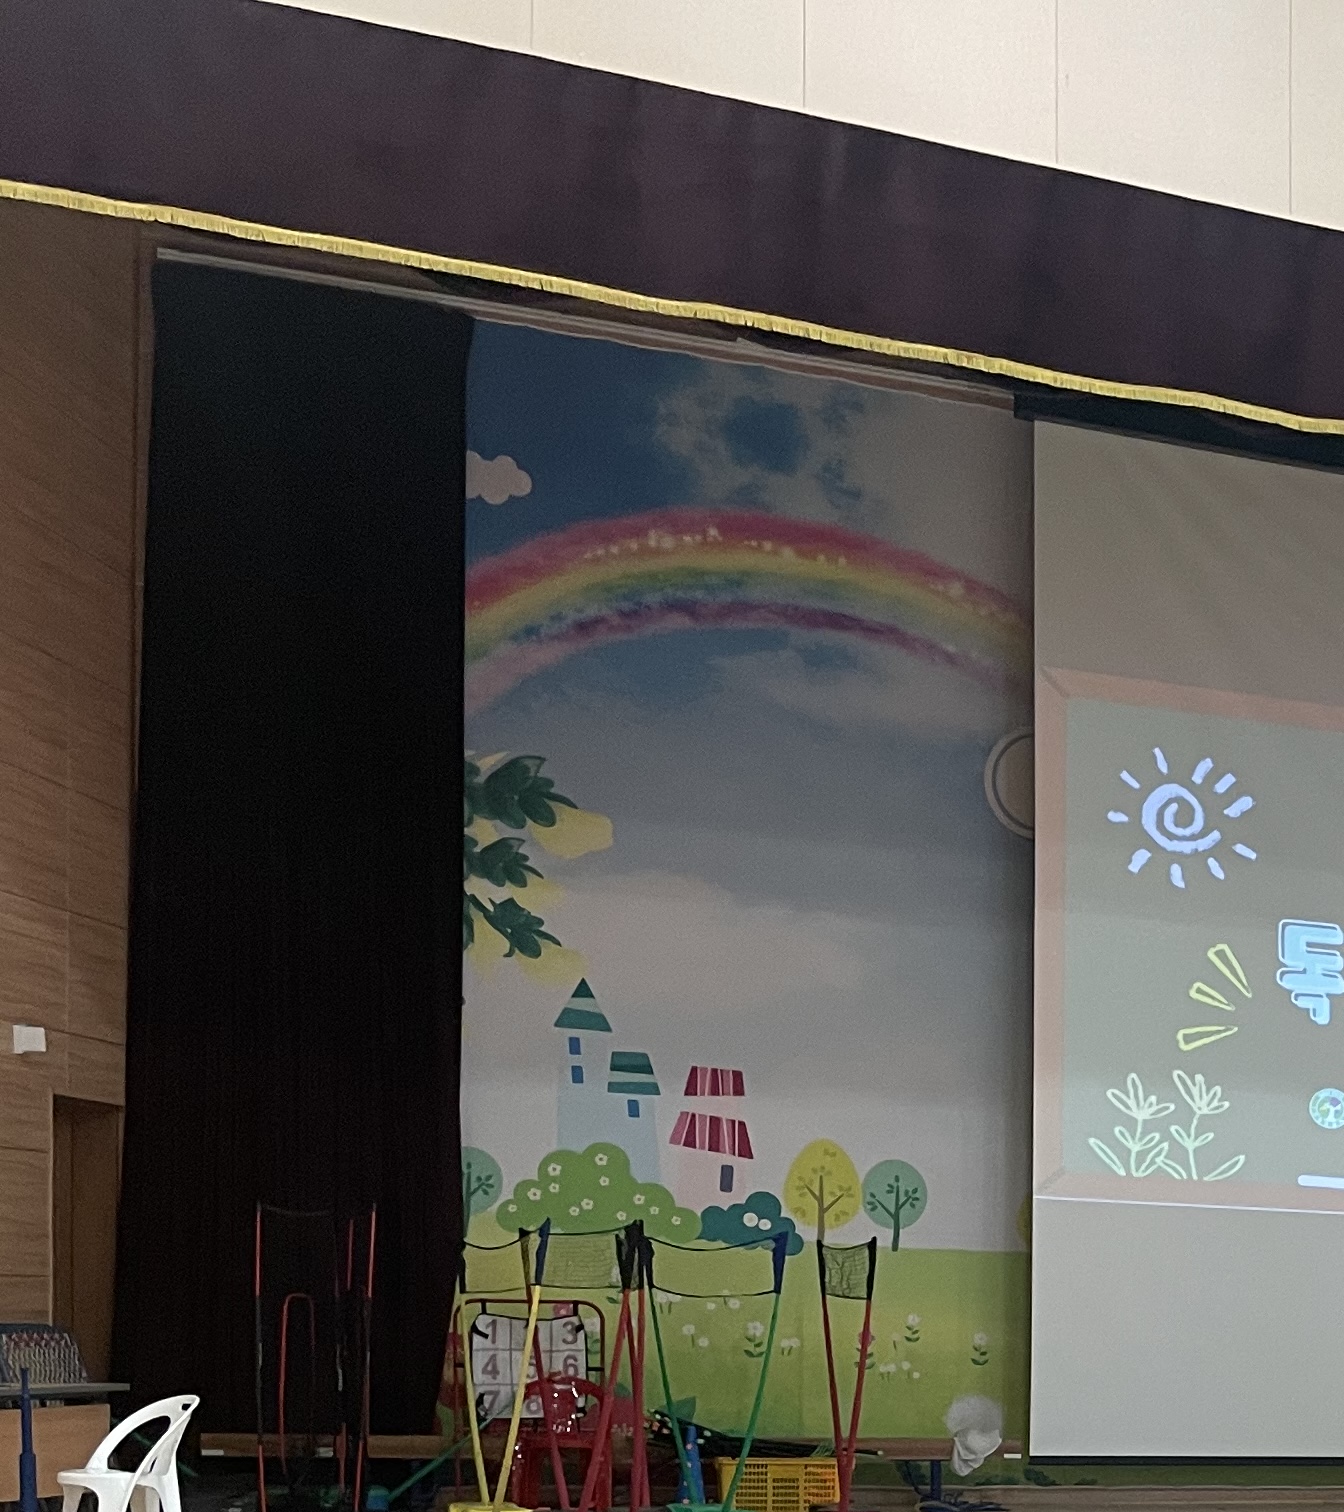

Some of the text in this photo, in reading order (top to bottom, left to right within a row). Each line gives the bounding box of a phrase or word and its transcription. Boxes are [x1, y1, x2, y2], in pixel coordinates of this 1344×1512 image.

[485, 1319, 578, 1345] 1 3
[481, 1353, 500, 1380] 4
[562, 1354, 579, 1377] 6
